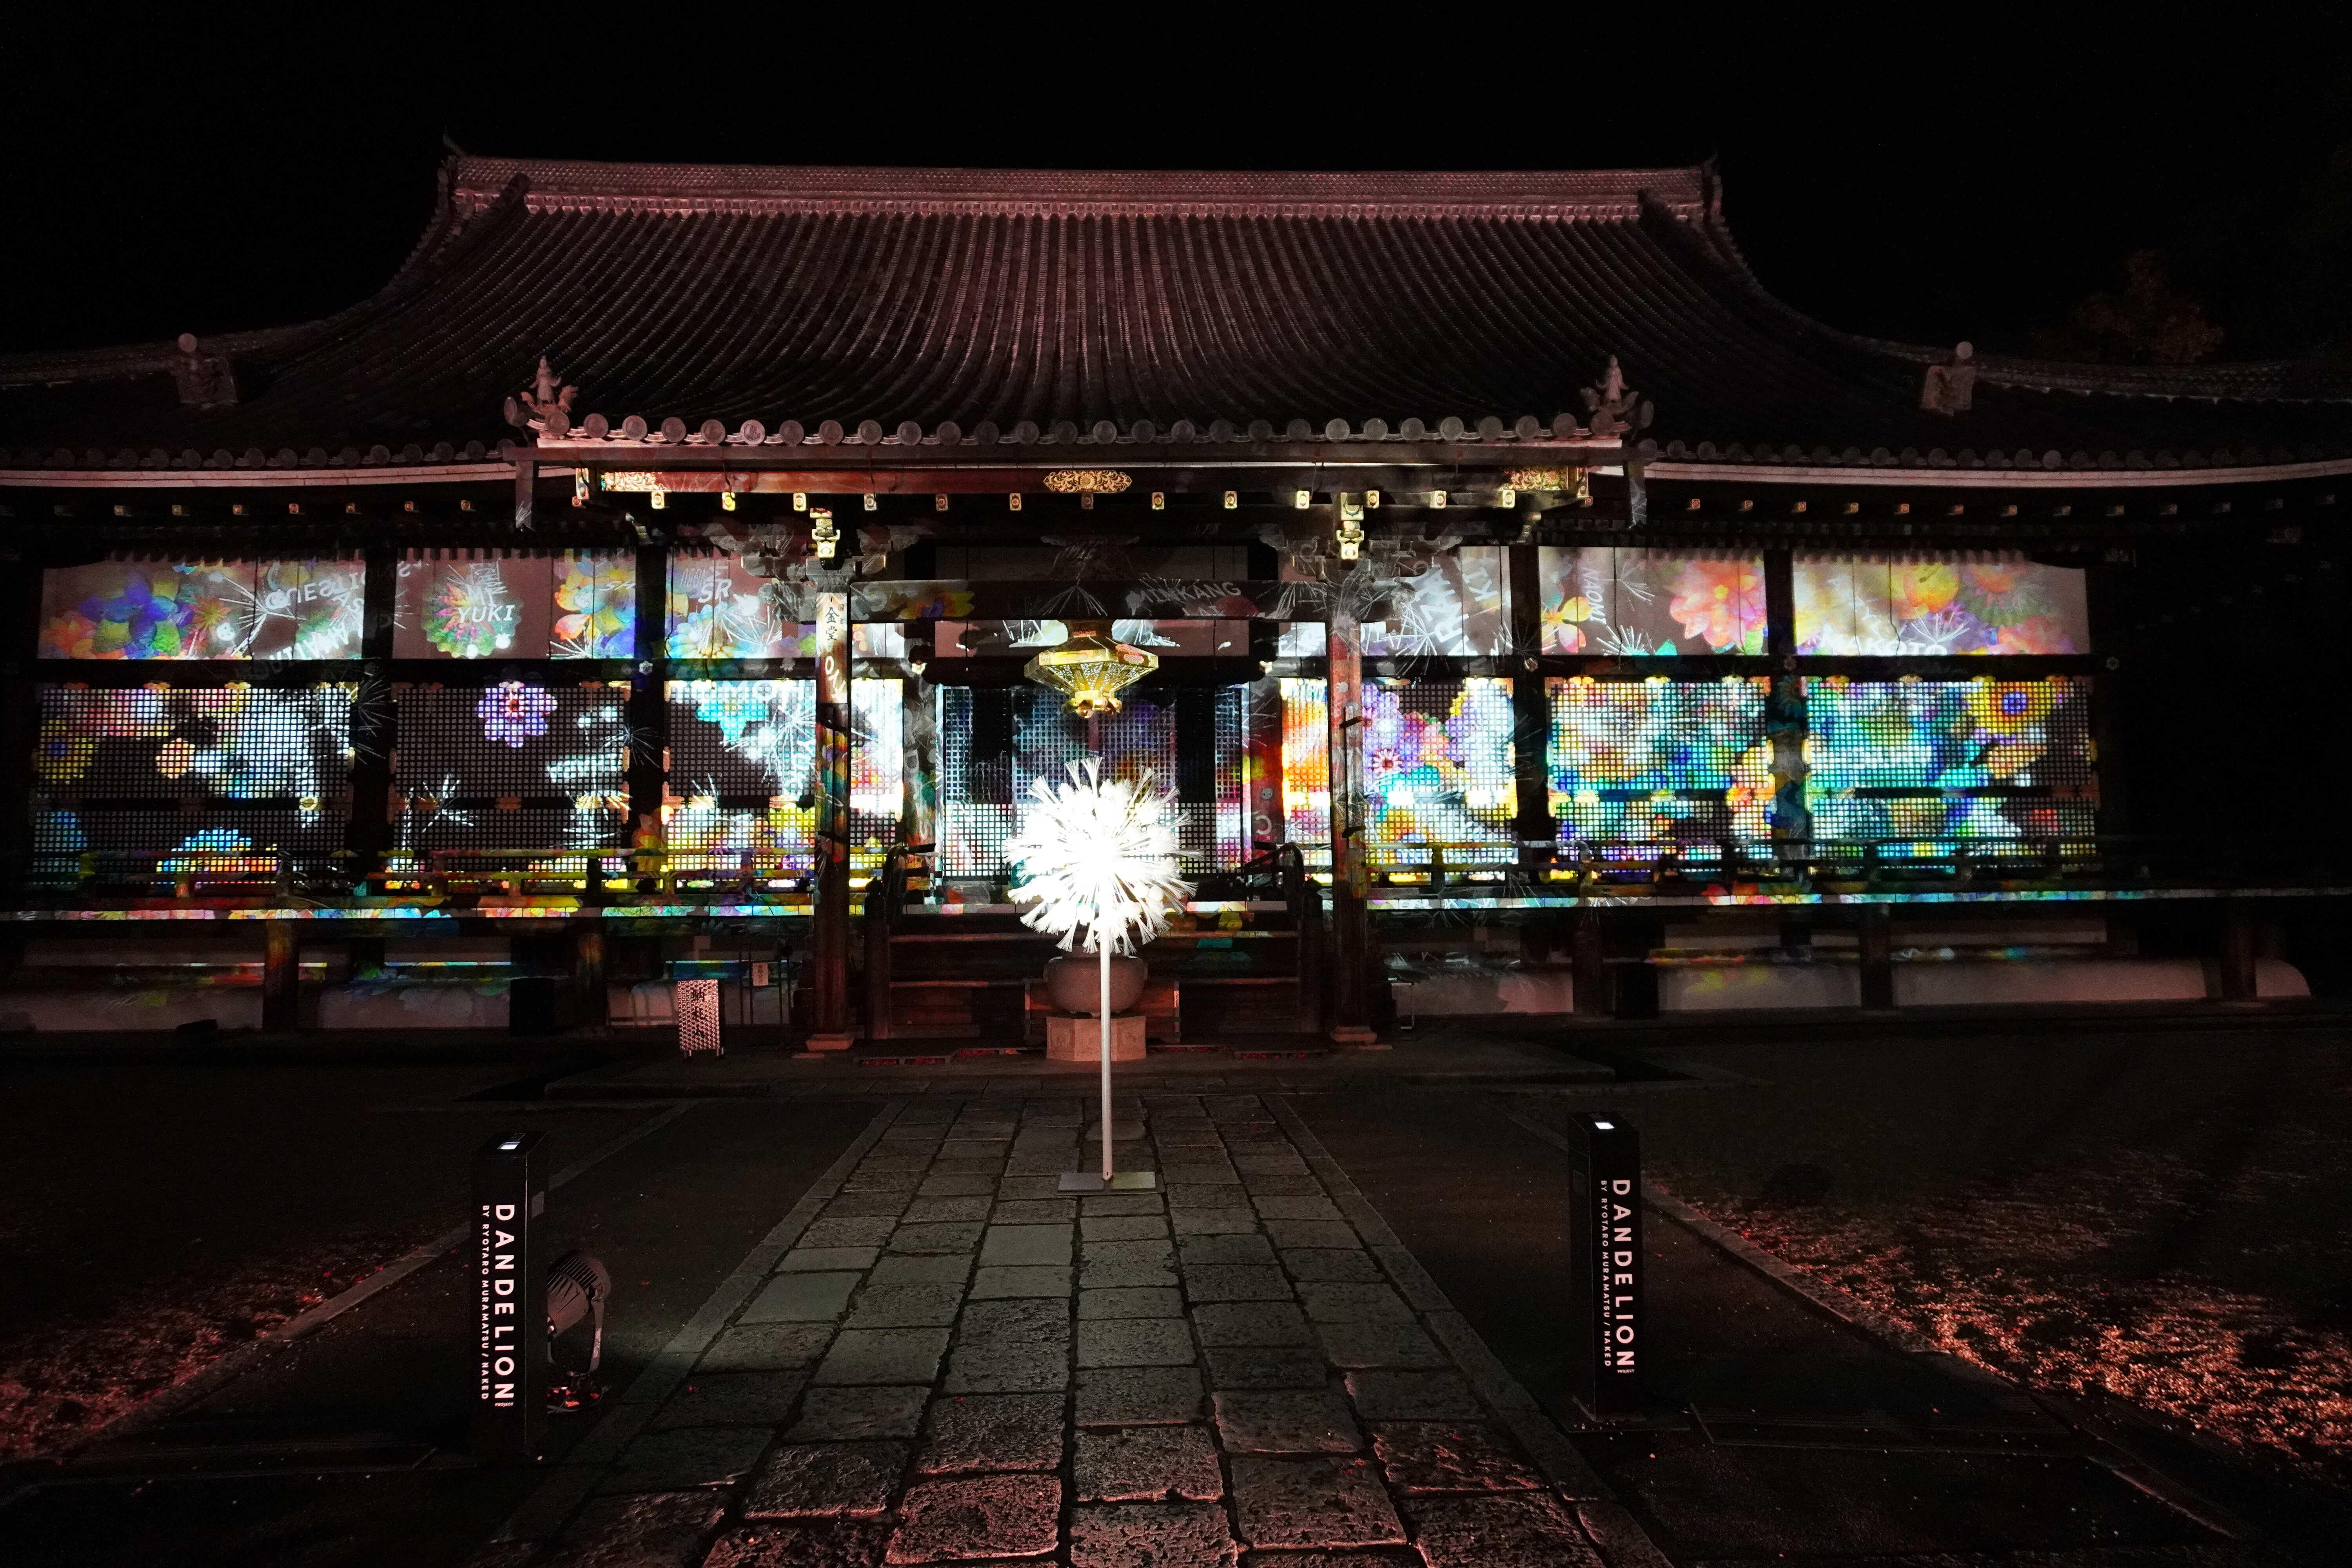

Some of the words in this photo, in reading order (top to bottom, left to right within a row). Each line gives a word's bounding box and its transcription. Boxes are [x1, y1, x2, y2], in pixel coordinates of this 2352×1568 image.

[457, 604, 515, 623] YUKI
[1582, 567, 1607, 625] NAOMI
[825, 606, 840, 641] 金堂
[1601, 1180, 1607, 1192] BY
[482, 1205, 490, 1217] BY
[481, 1223, 490, 1275] RYOTARO
[1613, 1180, 1635, 1366] DANDELION
[494, 1204, 515, 1399] DANDELION
[481, 1362, 489, 1399] NAKED
